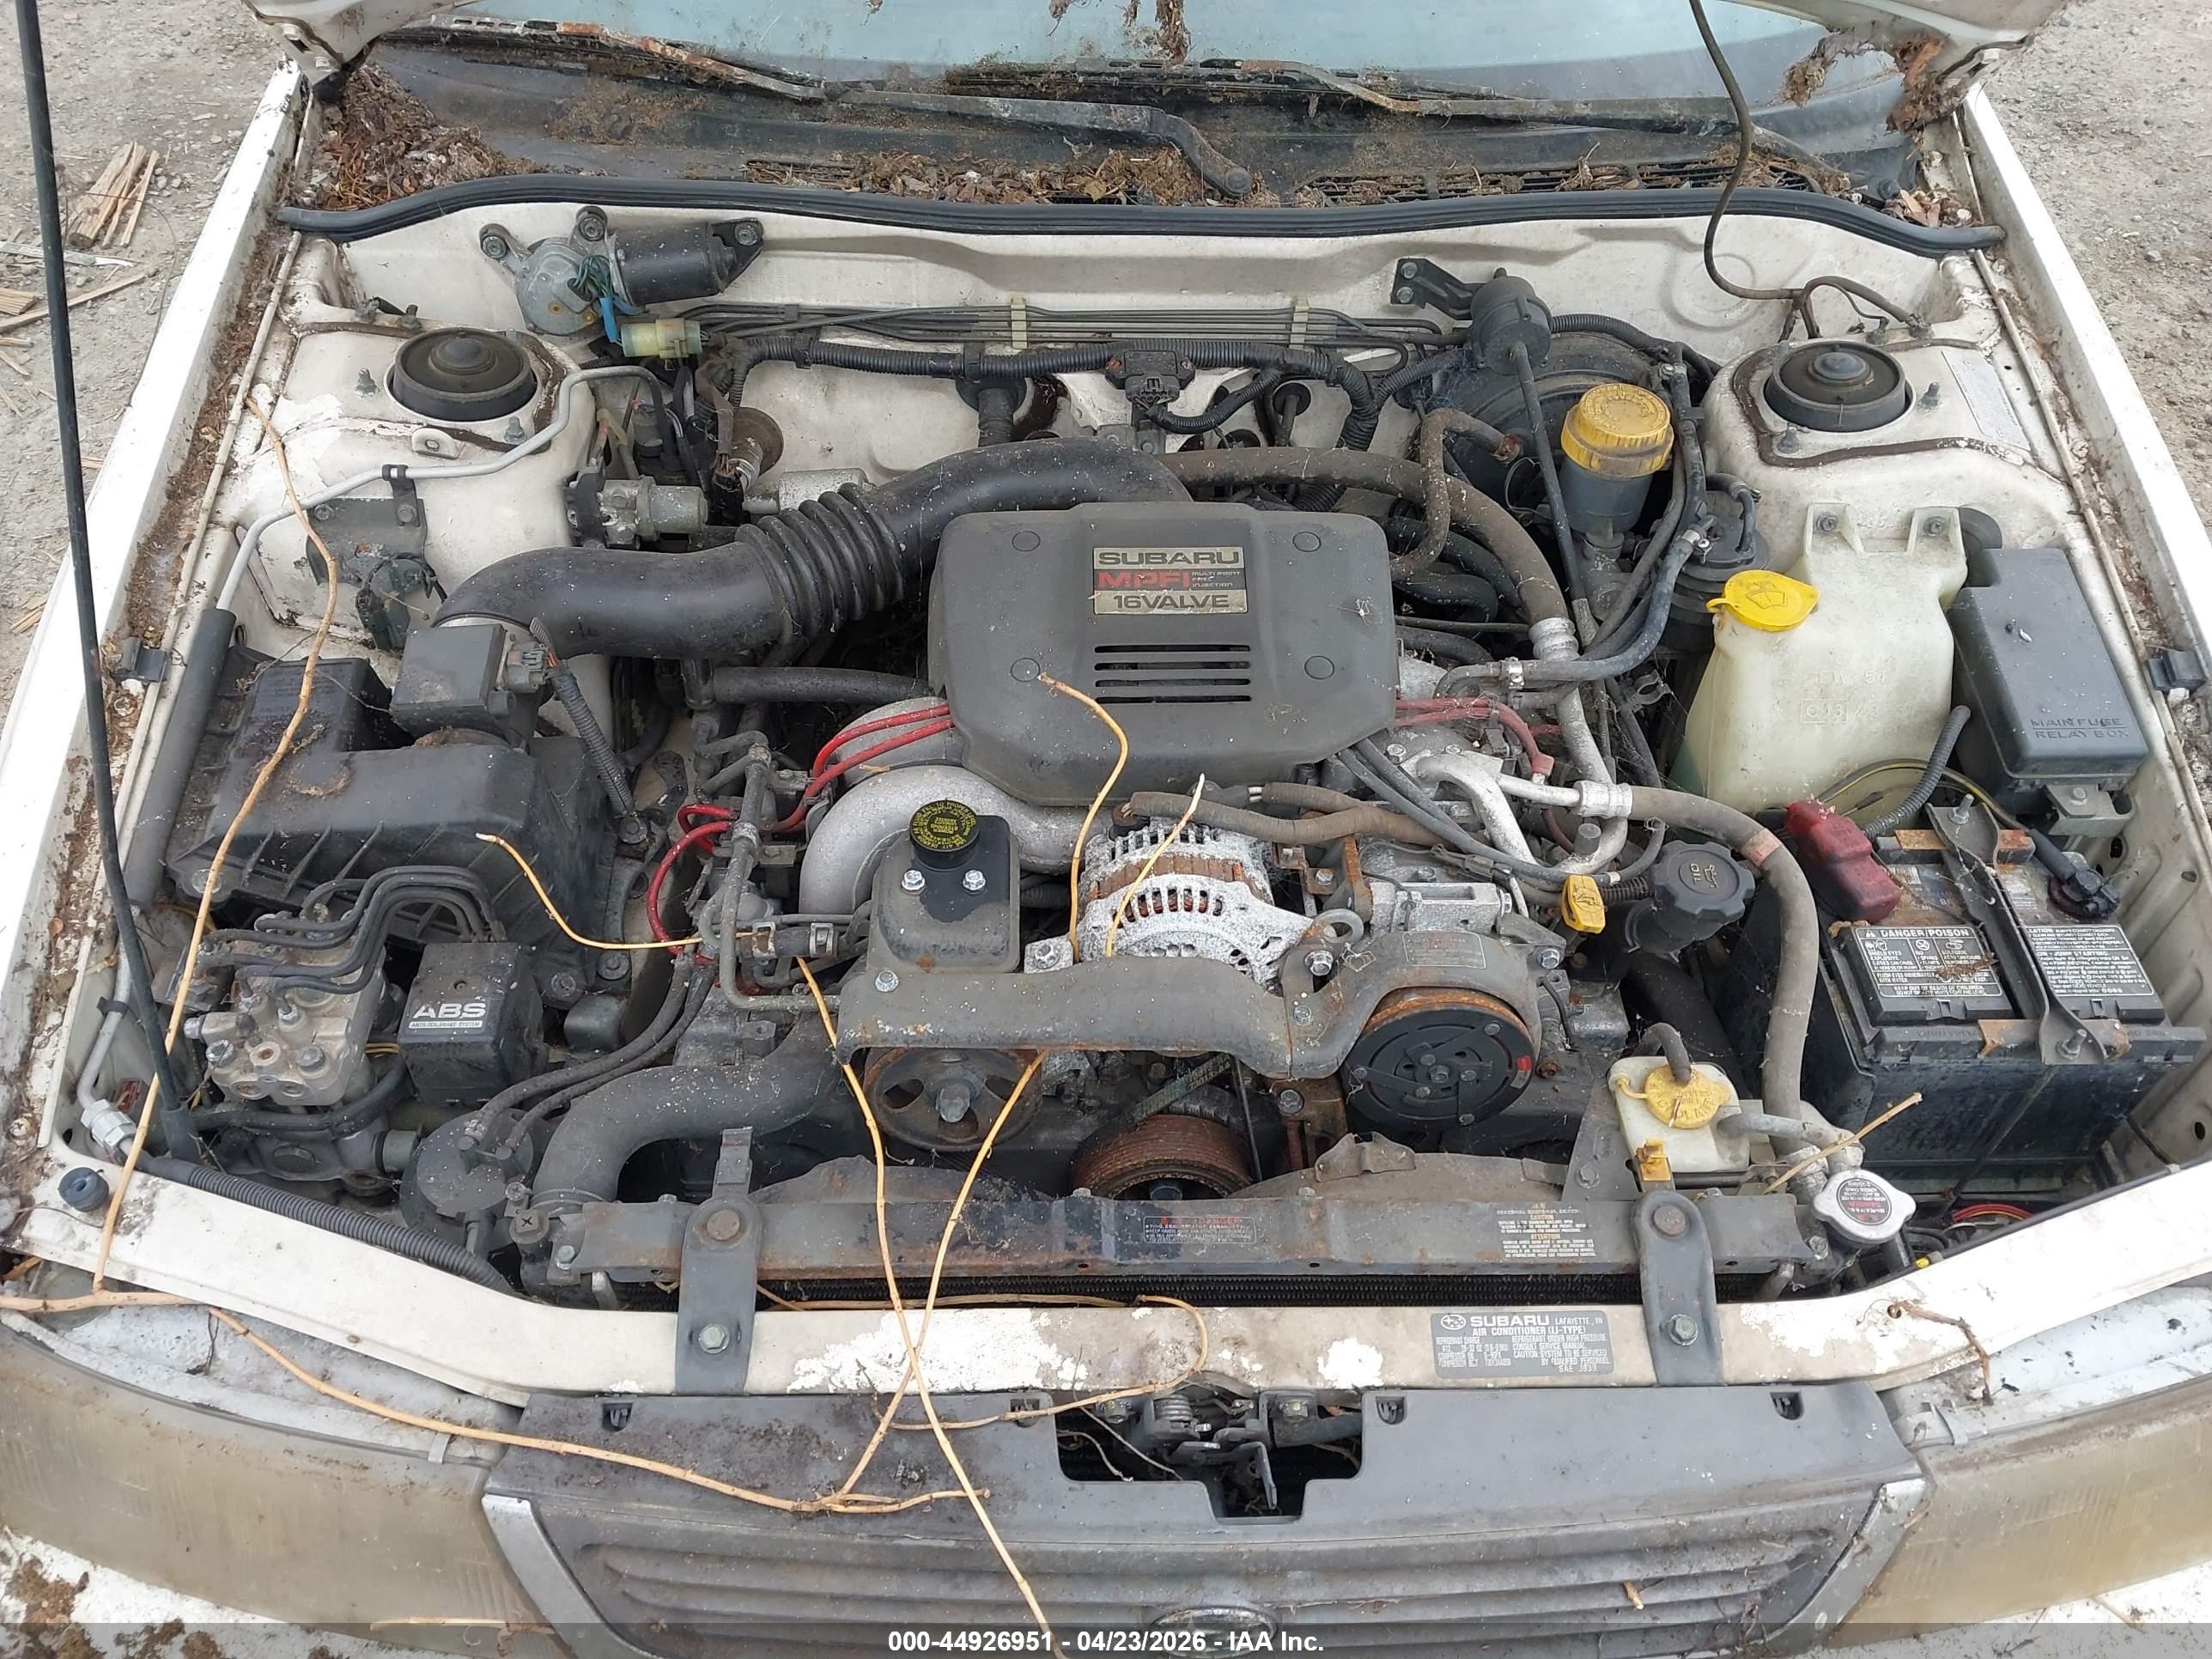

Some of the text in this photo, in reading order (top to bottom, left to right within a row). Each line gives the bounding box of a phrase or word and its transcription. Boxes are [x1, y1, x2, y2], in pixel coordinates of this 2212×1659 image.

[1098, 551, 1240, 565] SUBARU
[1098, 570, 1191, 588] MPFI
[1113, 594, 1231, 609] 16VALVE
[2030, 718, 2124, 727] MAIN FUSE
[2035, 730, 2130, 739] RELAY BOX
[1690, 862, 1701, 884] OIL
[412, 1002, 487, 1019] ABS
[1469, 1315, 1550, 1328] SUBARU
[1472, 1328, 1487, 1336] AIR
[1491, 1326, 1547, 1336] CONDITIONER
